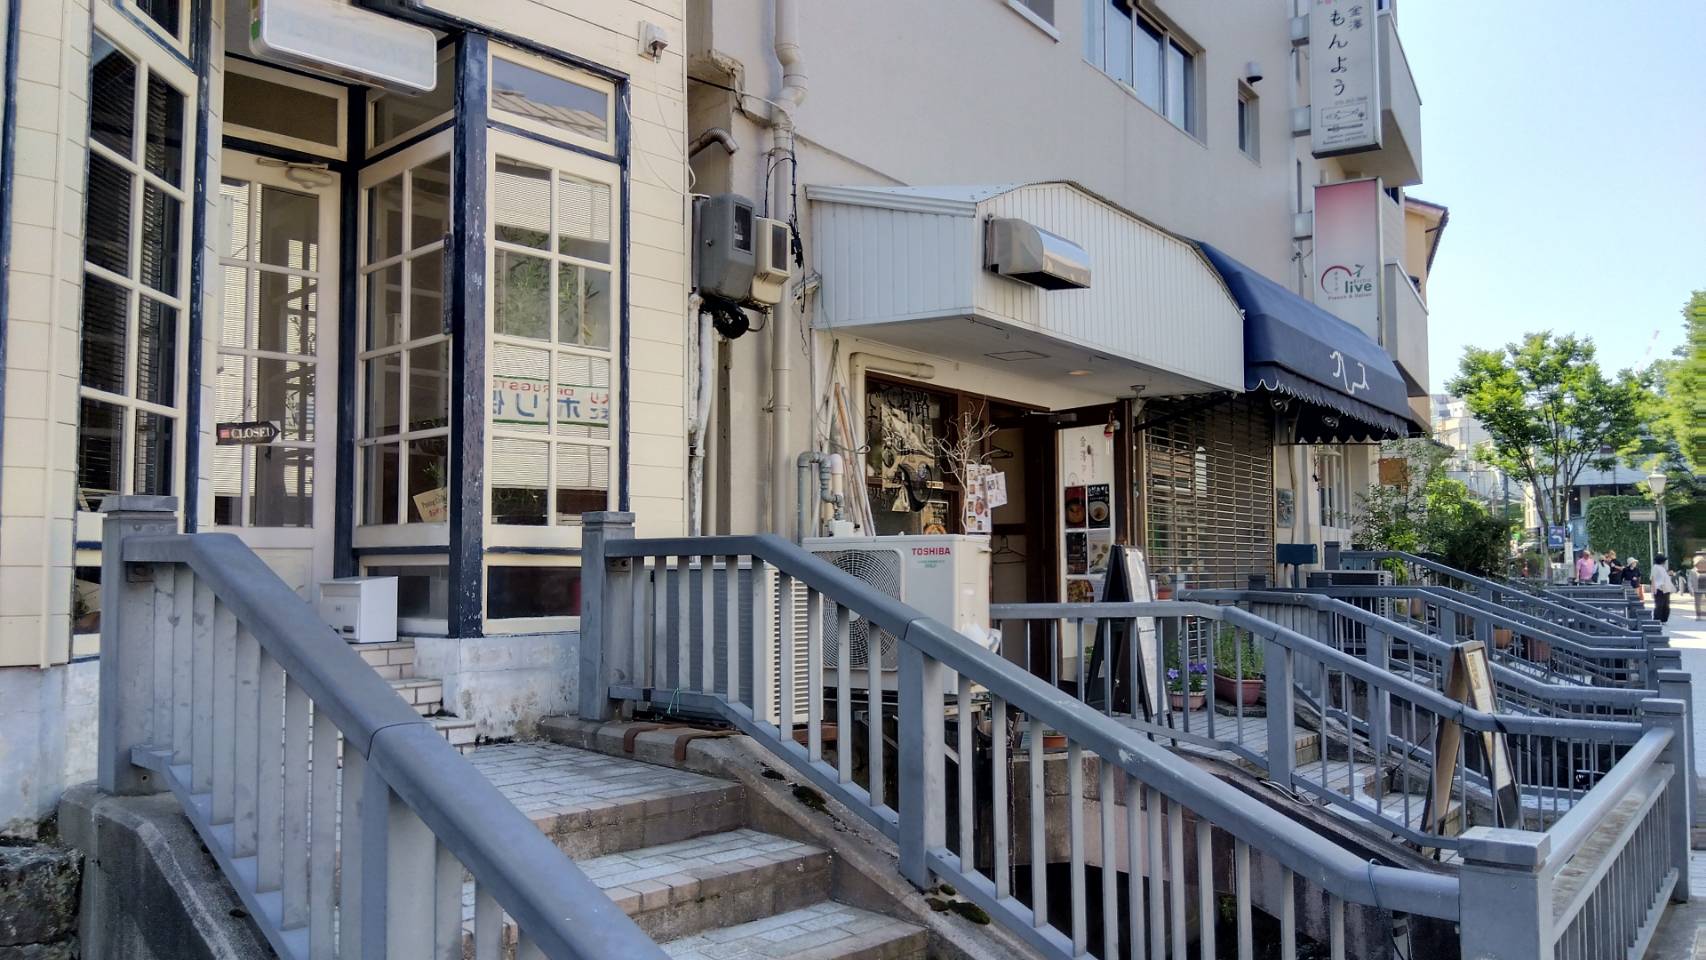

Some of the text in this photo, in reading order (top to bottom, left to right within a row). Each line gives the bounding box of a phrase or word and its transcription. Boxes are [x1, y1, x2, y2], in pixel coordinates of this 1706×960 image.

[1329, 10, 1348, 96] もんよう
[231, 427, 275, 439] CLOSED
[912, 547, 951, 555] TOSHIBA
